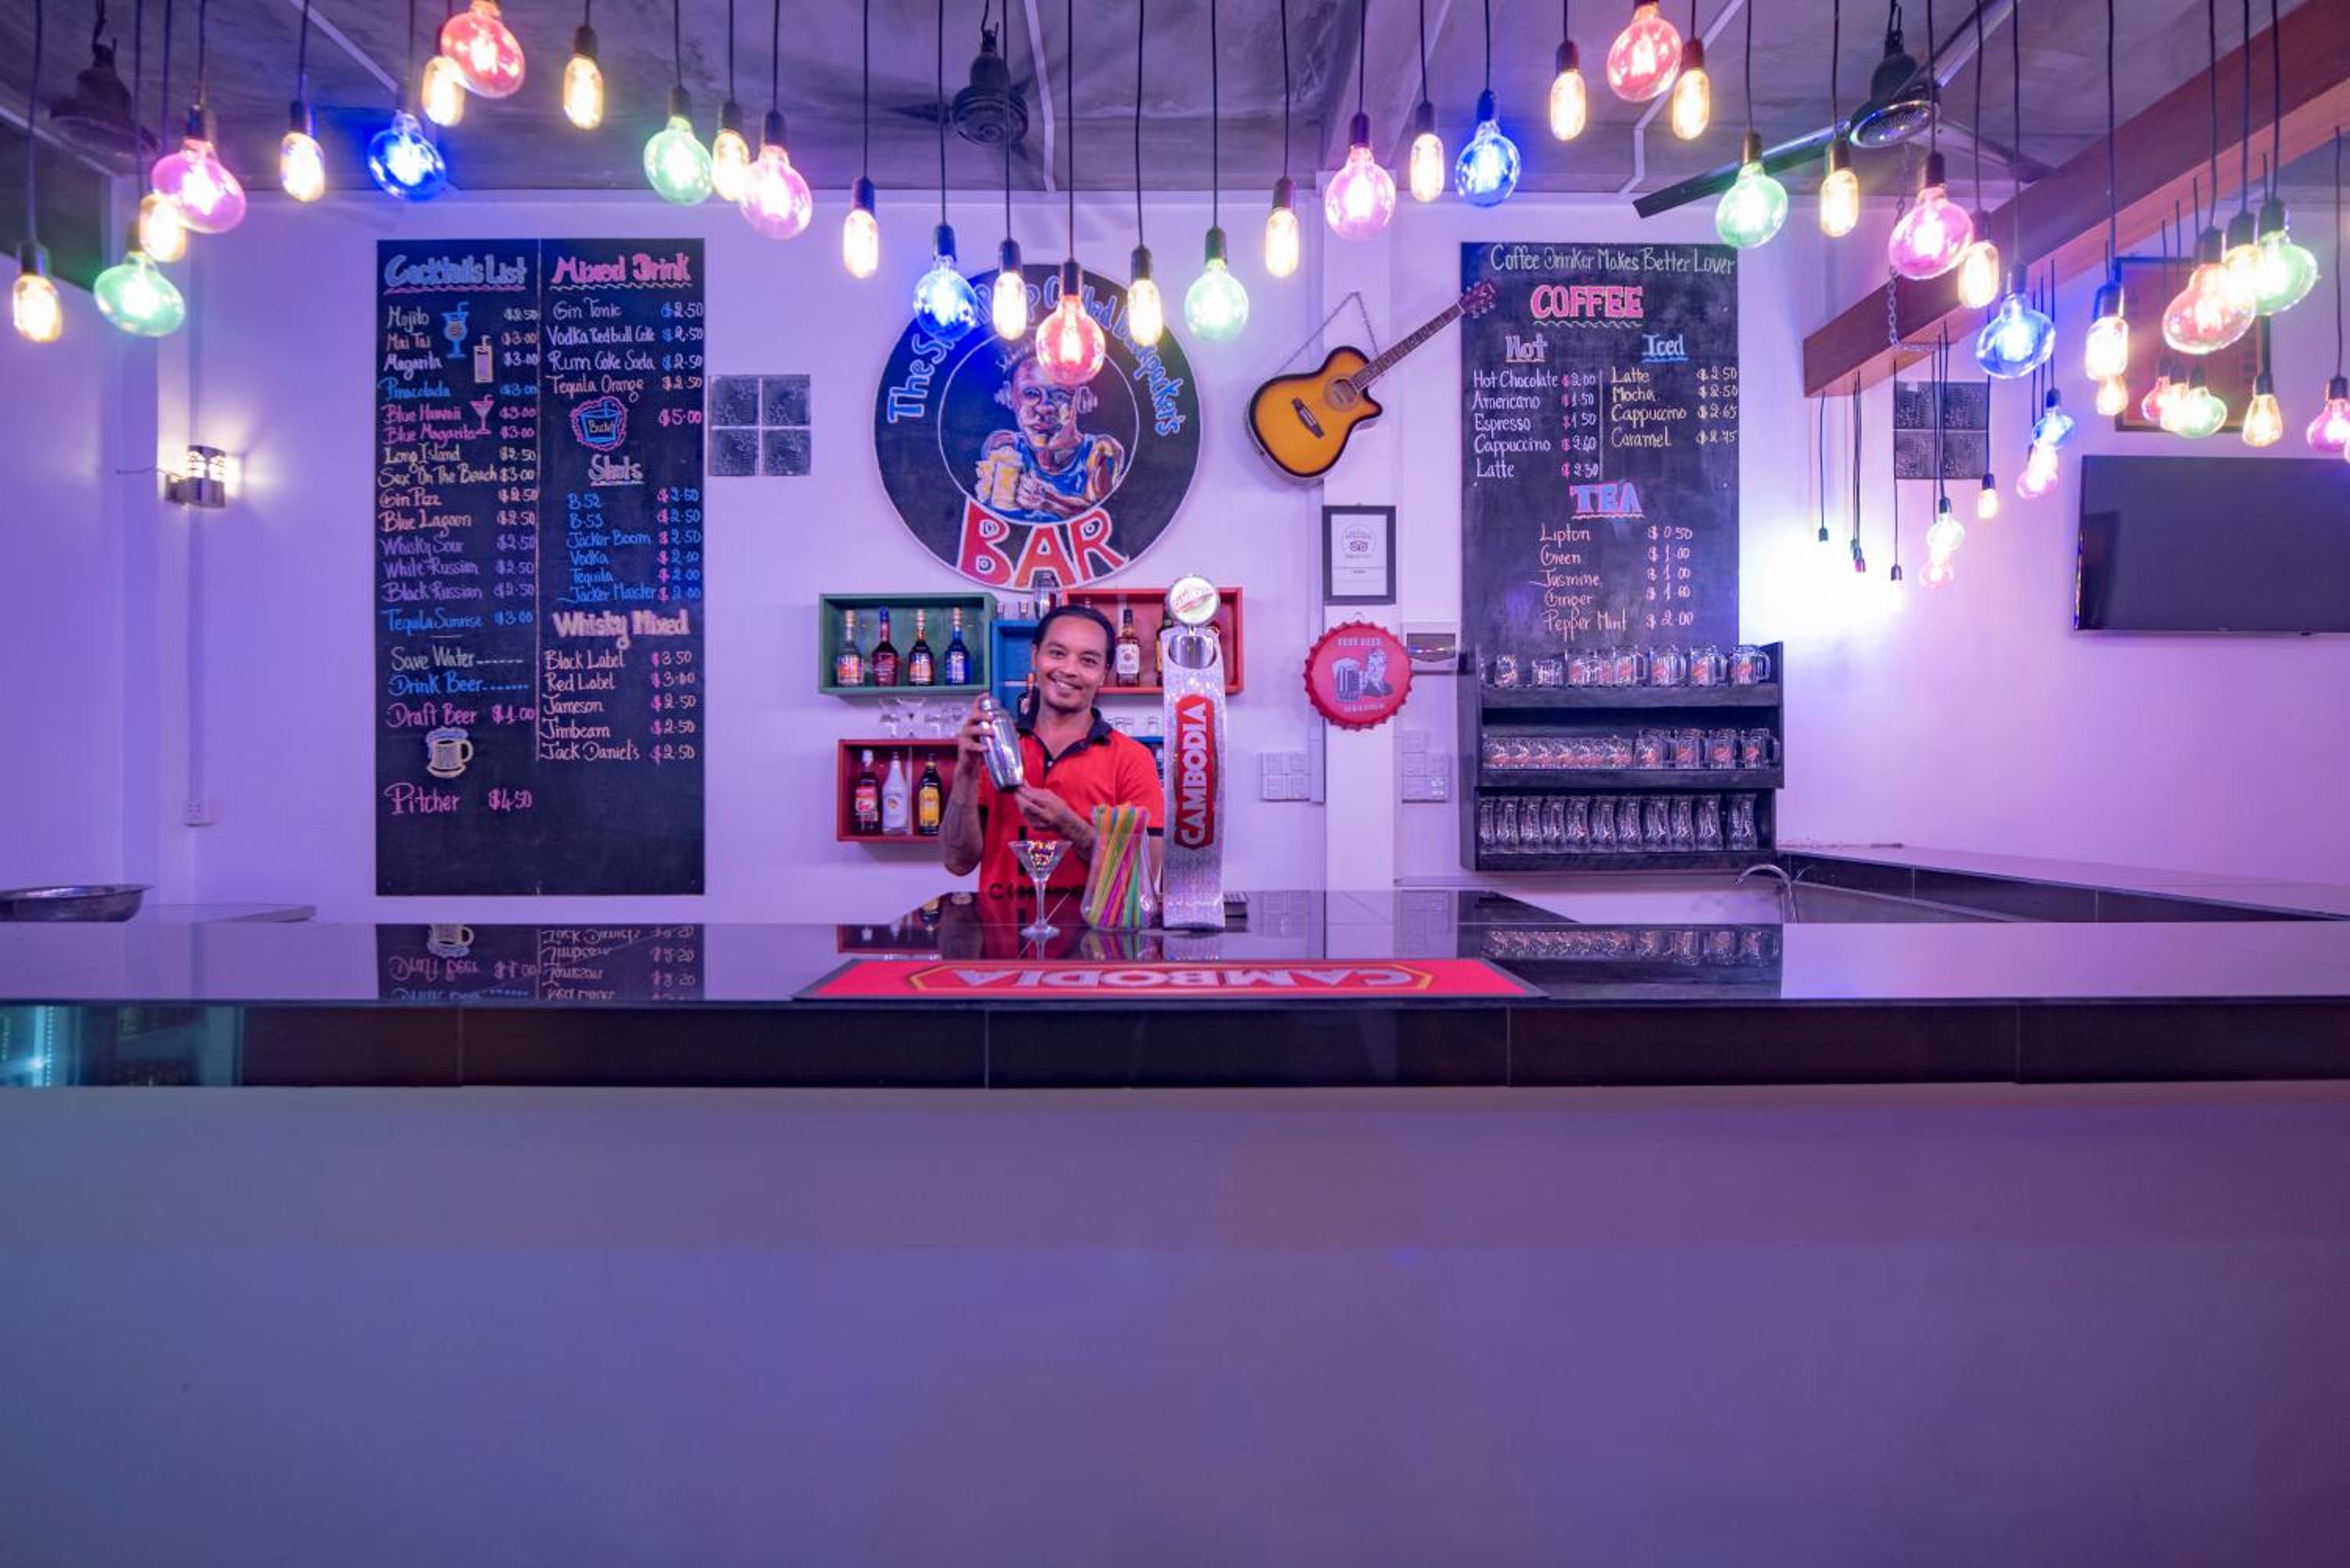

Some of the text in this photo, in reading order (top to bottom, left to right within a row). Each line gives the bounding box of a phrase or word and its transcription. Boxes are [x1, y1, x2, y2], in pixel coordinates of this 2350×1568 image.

[384, 254, 528, 287] Cocktails List
[551, 252, 692, 284] Mixed Drink
[1490, 244, 1539, 271] Coffee
[1597, 247, 1639, 272] Makes
[1641, 246, 1690, 272] Better
[1693, 247, 1736, 274] Lover
[553, 301, 583, 320] Gin
[584, 297, 621, 318] Tonic
[1531, 284, 1643, 320] COFFEE
[386, 305, 429, 333] Mojito
[386, 332, 410, 352] Mai
[1506, 332, 1549, 360] Hot
[1642, 333, 1685, 356] Iced
[547, 349, 591, 371] Rum
[624, 349, 656, 371] Soda
[1473, 368, 1498, 388] Hot
[1499, 367, 1558, 388] Chocolate
[1611, 366, 1650, 383] Latte
[546, 373, 598, 399] Tequila
[601, 374, 644, 403] Orange
[888, 359, 935, 424] The
[1612, 385, 1655, 403] Mocha
[1473, 390, 1541, 410] Americano
[381, 404, 416, 424] Blue
[658, 408, 703, 427] $5.00
[382, 426, 417, 446] Blue
[1473, 413, 1531, 439] Espresso
[1611, 426, 1672, 448] Caramel
[384, 446, 419, 473] Long
[418, 442, 461, 464] Island
[1476, 456, 1515, 479] Latte
[418, 465, 433, 485] On
[432, 464, 456, 484] The
[457, 462, 497, 484] Beach
[379, 487, 410, 508] Gin
[1568, 481, 1643, 514] TEA
[378, 510, 417, 532] Blue
[418, 509, 472, 539] Lagoon
[1538, 522, 1591, 548] Lipton
[433, 534, 464, 553] Sour
[611, 529, 652, 546] Boom
[957, 495, 1130, 590] BAR
[1540, 543, 1581, 566] Green
[382, 557, 428, 580] White
[424, 556, 479, 575] Russian
[381, 581, 429, 602] Black
[430, 580, 483, 601] Russian
[381, 609, 433, 636] Tequila
[631, 609, 690, 635] Mixed
[1541, 608, 1590, 642] Pepper
[1597, 608, 1627, 631] Mint
[392, 646, 428, 671] Save
[544, 649, 584, 670] Black
[588, 648, 627, 670] Label
[388, 674, 441, 696] Drink
[544, 671, 575, 692] Red
[577, 670, 617, 691] Label
[385, 703, 437, 728] Draft
[442, 702, 477, 725] Beer
[541, 693, 605, 715] Jameson
[540, 716, 611, 739] Jimbeam
[540, 741, 580, 761] Jack
[1181, 701, 1207, 846] CAMBODIA
[384, 782, 461, 815] Pitcher
[952, 969, 1412, 988] CAMBODIA
